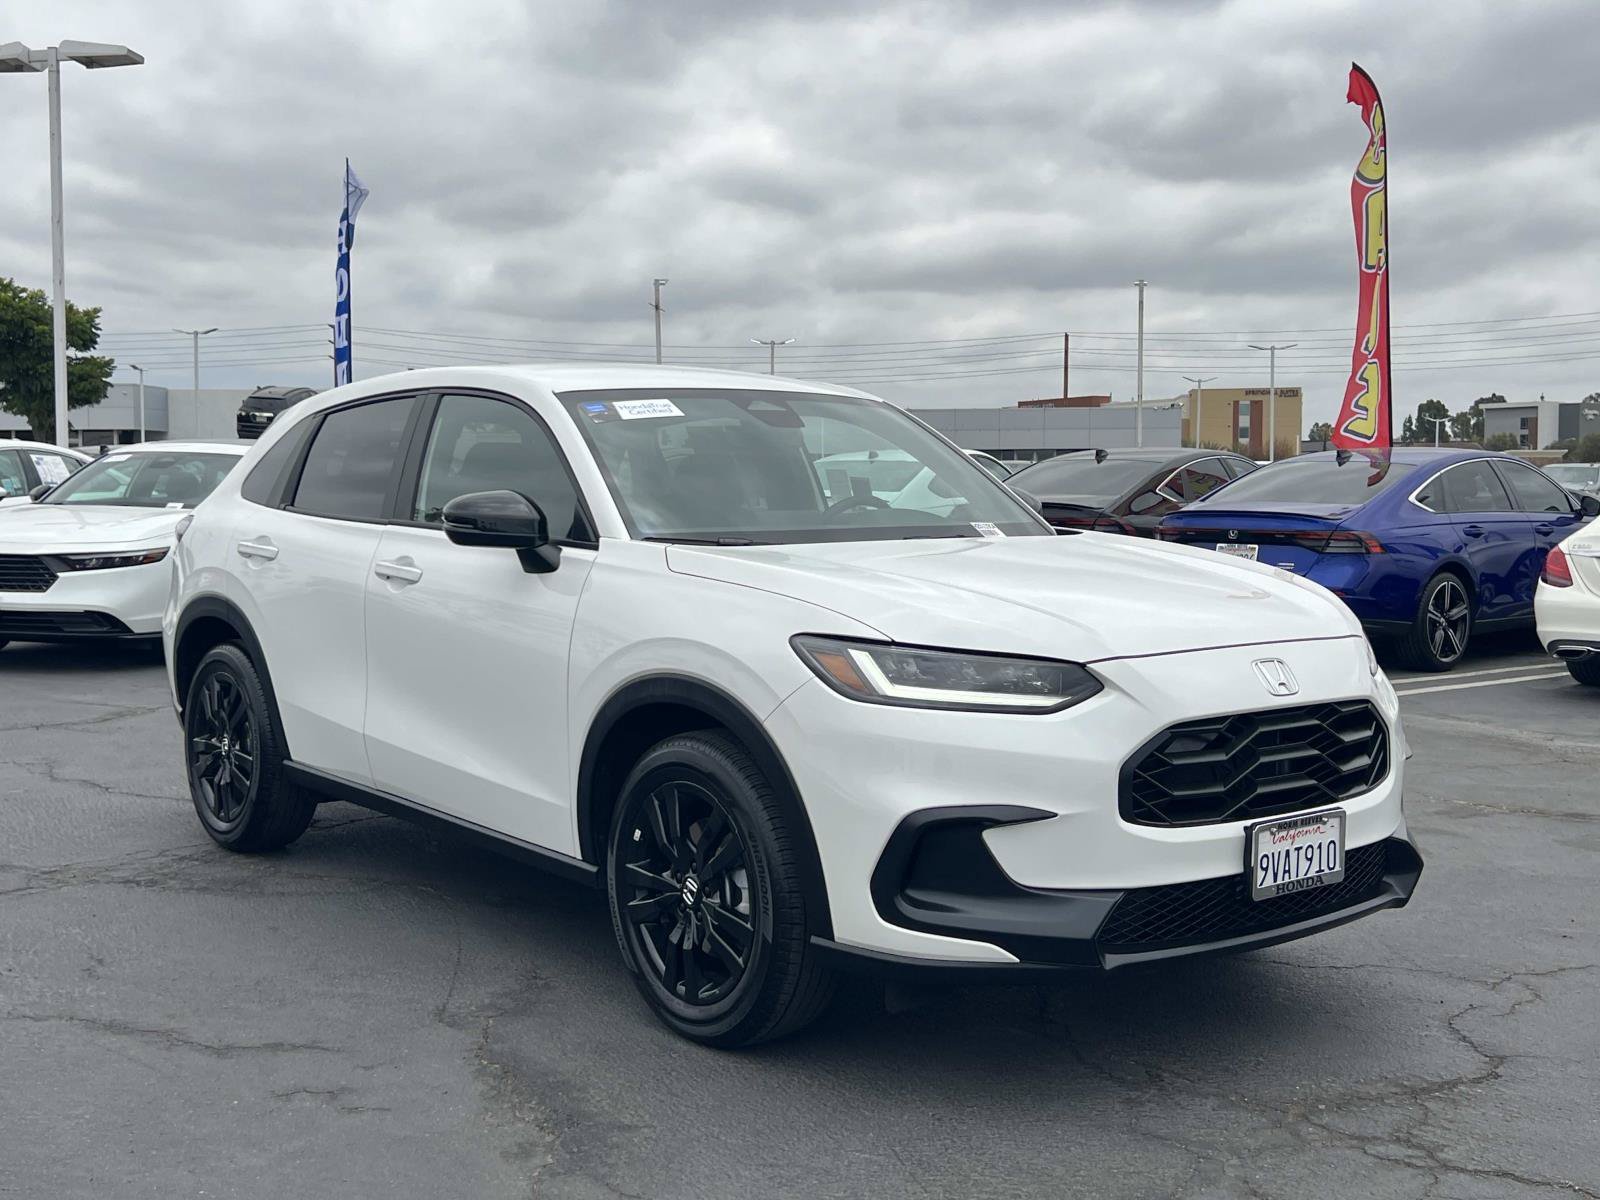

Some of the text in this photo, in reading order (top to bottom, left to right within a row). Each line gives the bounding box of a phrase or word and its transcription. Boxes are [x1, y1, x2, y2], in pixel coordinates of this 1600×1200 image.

[1272, 825, 1326, 845] California
[1259, 839, 1337, 887] 9VAT910
[1275, 876, 1324, 895] HONDA
